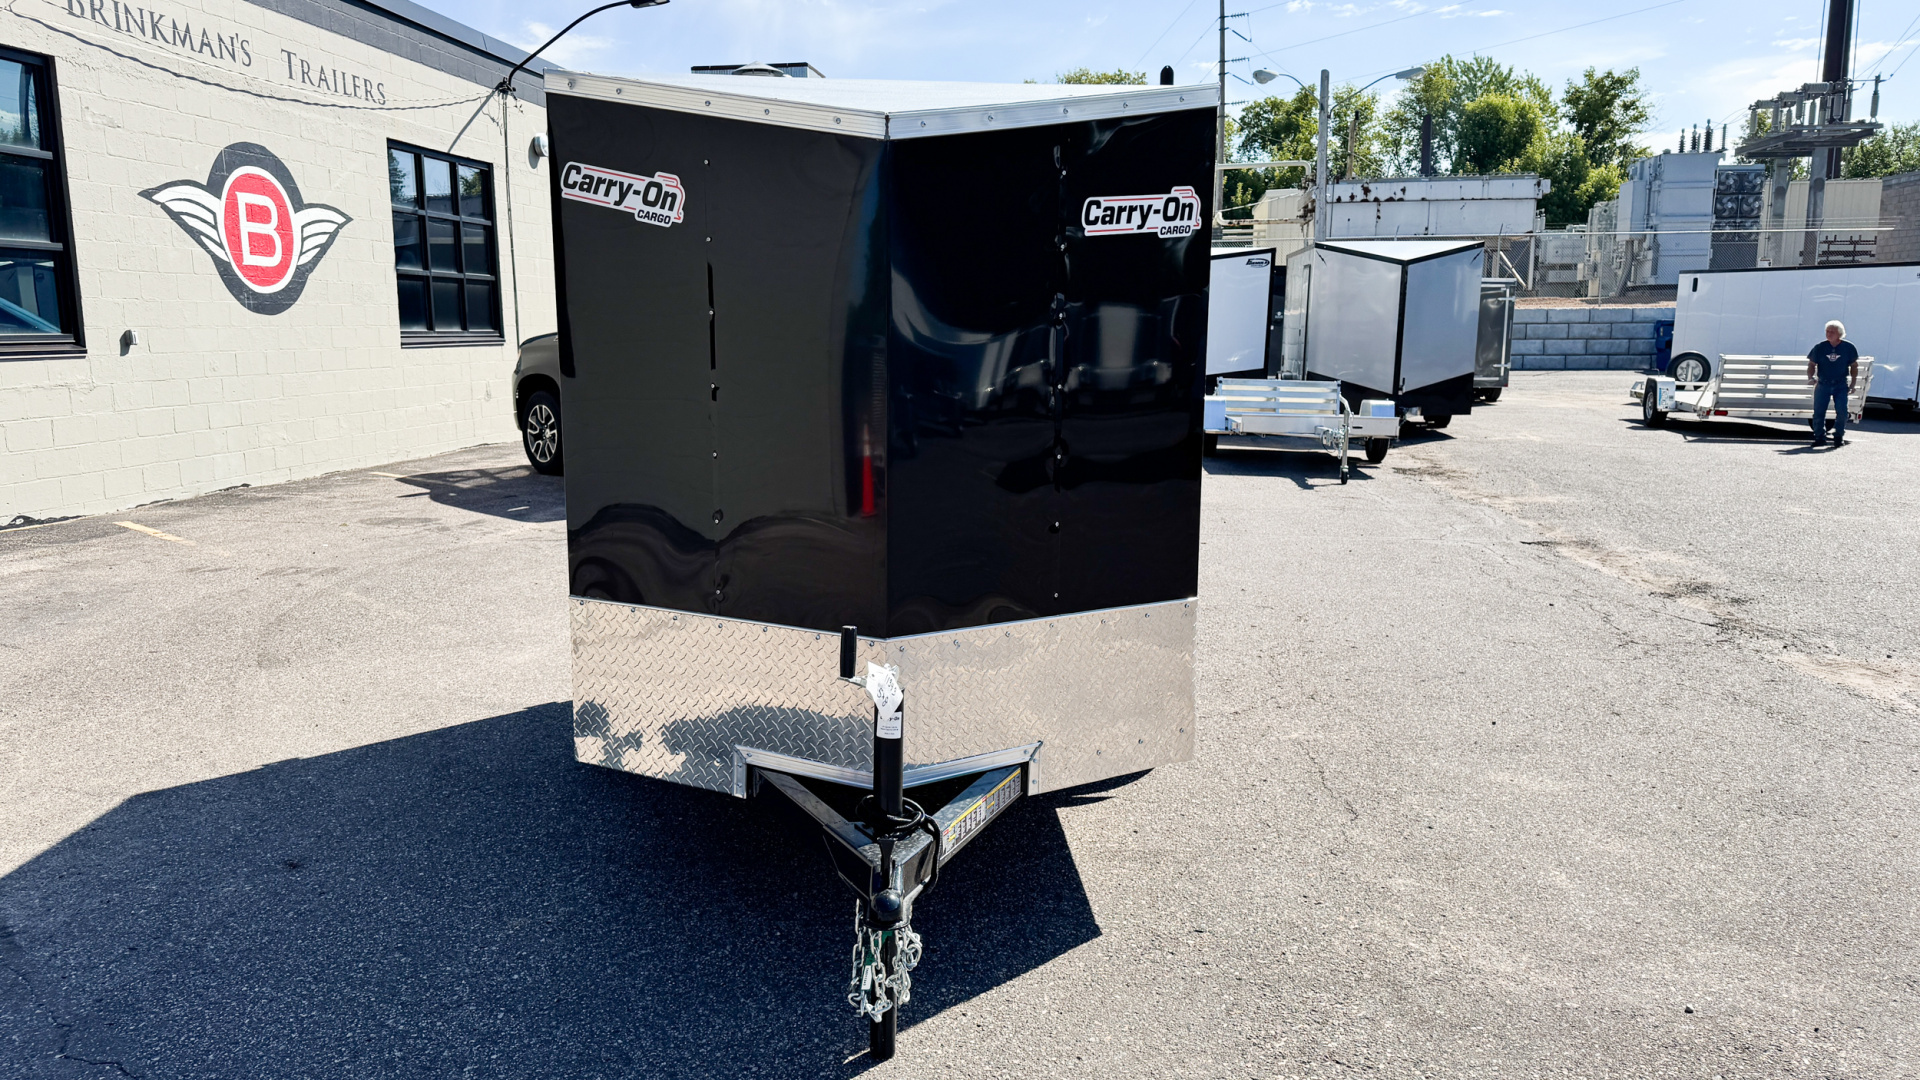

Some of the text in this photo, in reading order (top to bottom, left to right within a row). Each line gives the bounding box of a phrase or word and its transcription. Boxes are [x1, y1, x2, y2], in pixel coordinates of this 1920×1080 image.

[281, 48, 387, 106] TRAILERS
[563, 164, 677, 212] Carry-On
[235, 191, 282, 267] B
[637, 209, 671, 225] CARGO
[1084, 196, 1194, 230] Carry-On
[1160, 225, 1191, 235] CARGO
